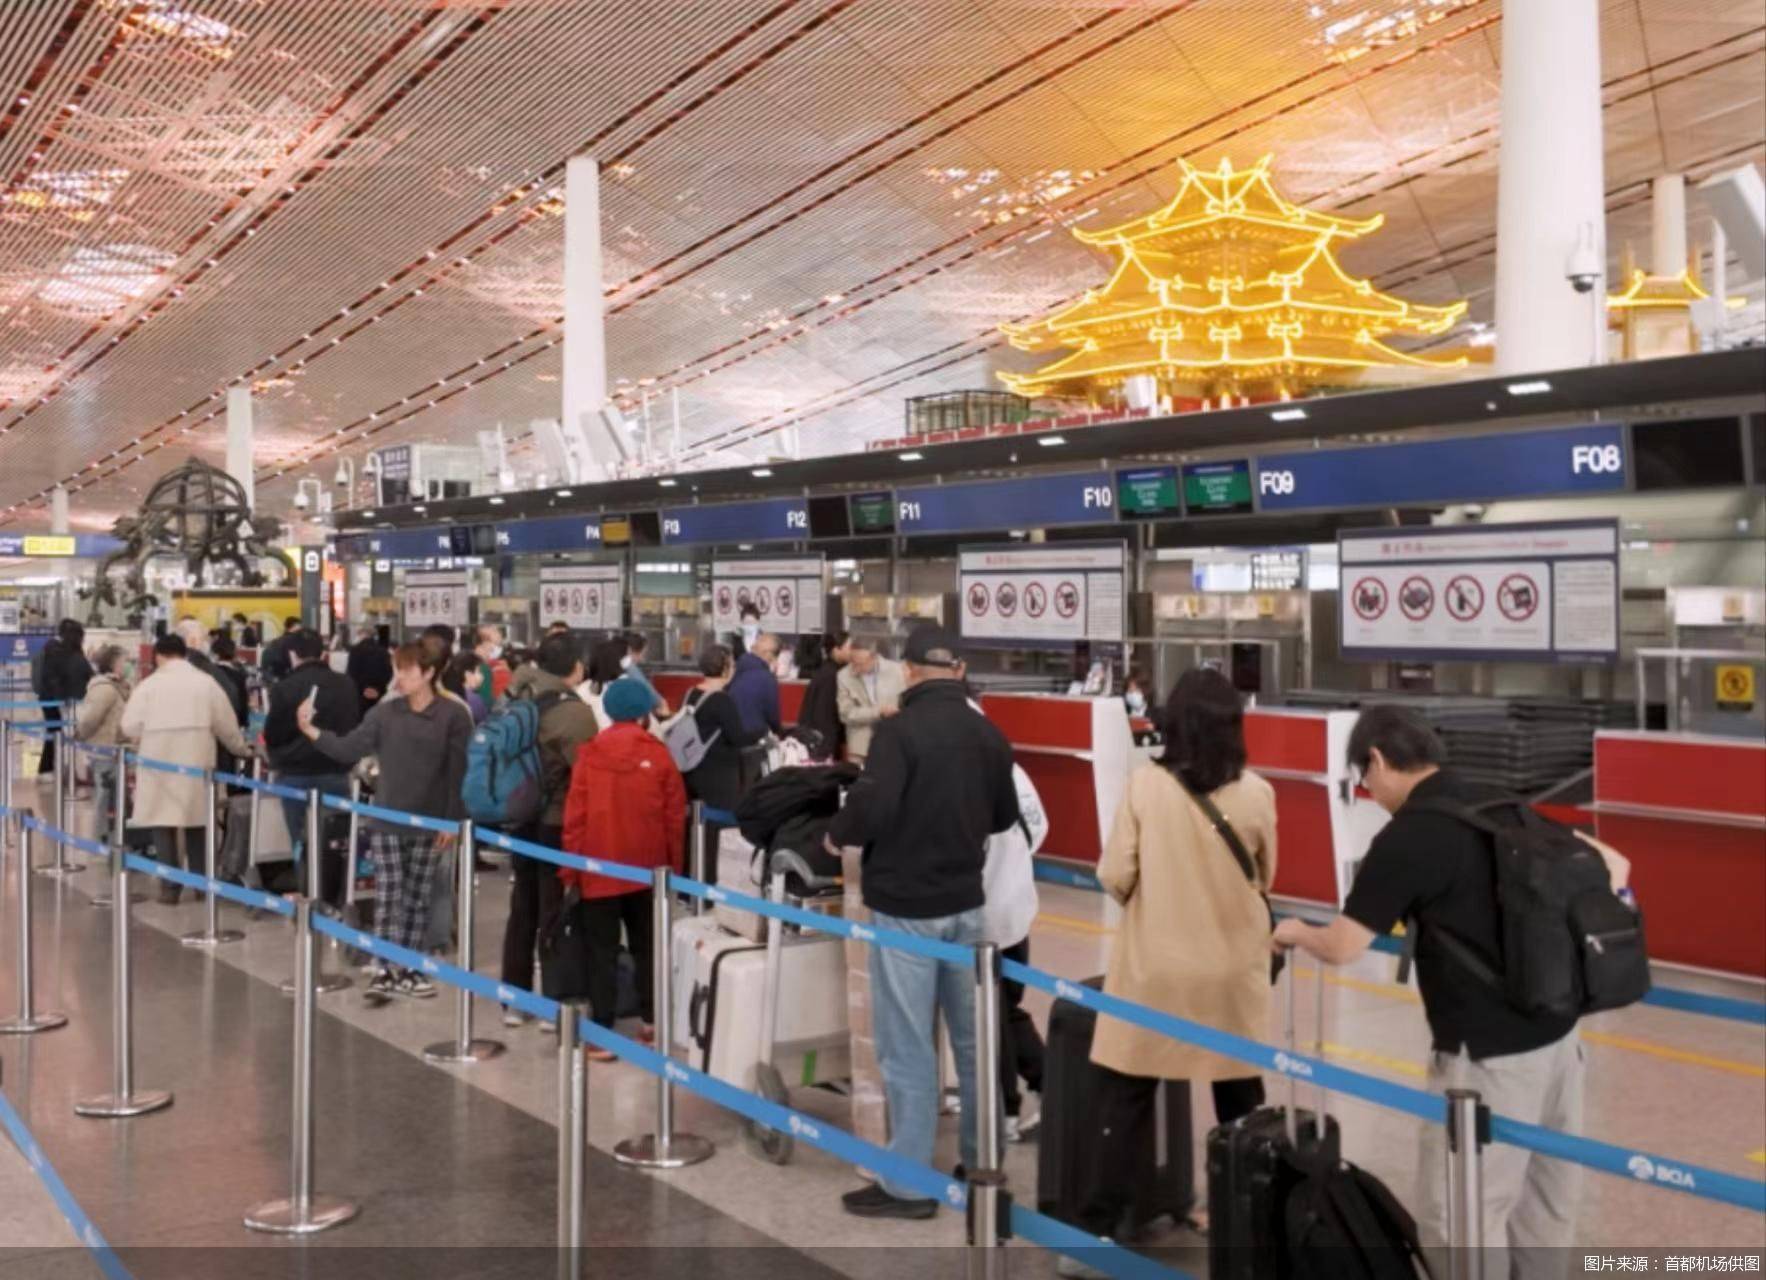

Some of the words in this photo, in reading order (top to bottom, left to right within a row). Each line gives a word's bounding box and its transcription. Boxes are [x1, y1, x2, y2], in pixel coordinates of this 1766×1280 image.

[1572, 444, 1622, 475] F08
[1260, 469, 1294, 496] F09
[1084, 487, 1112, 508] F10
[786, 511, 807, 528] F12
[899, 502, 921, 519] F11
